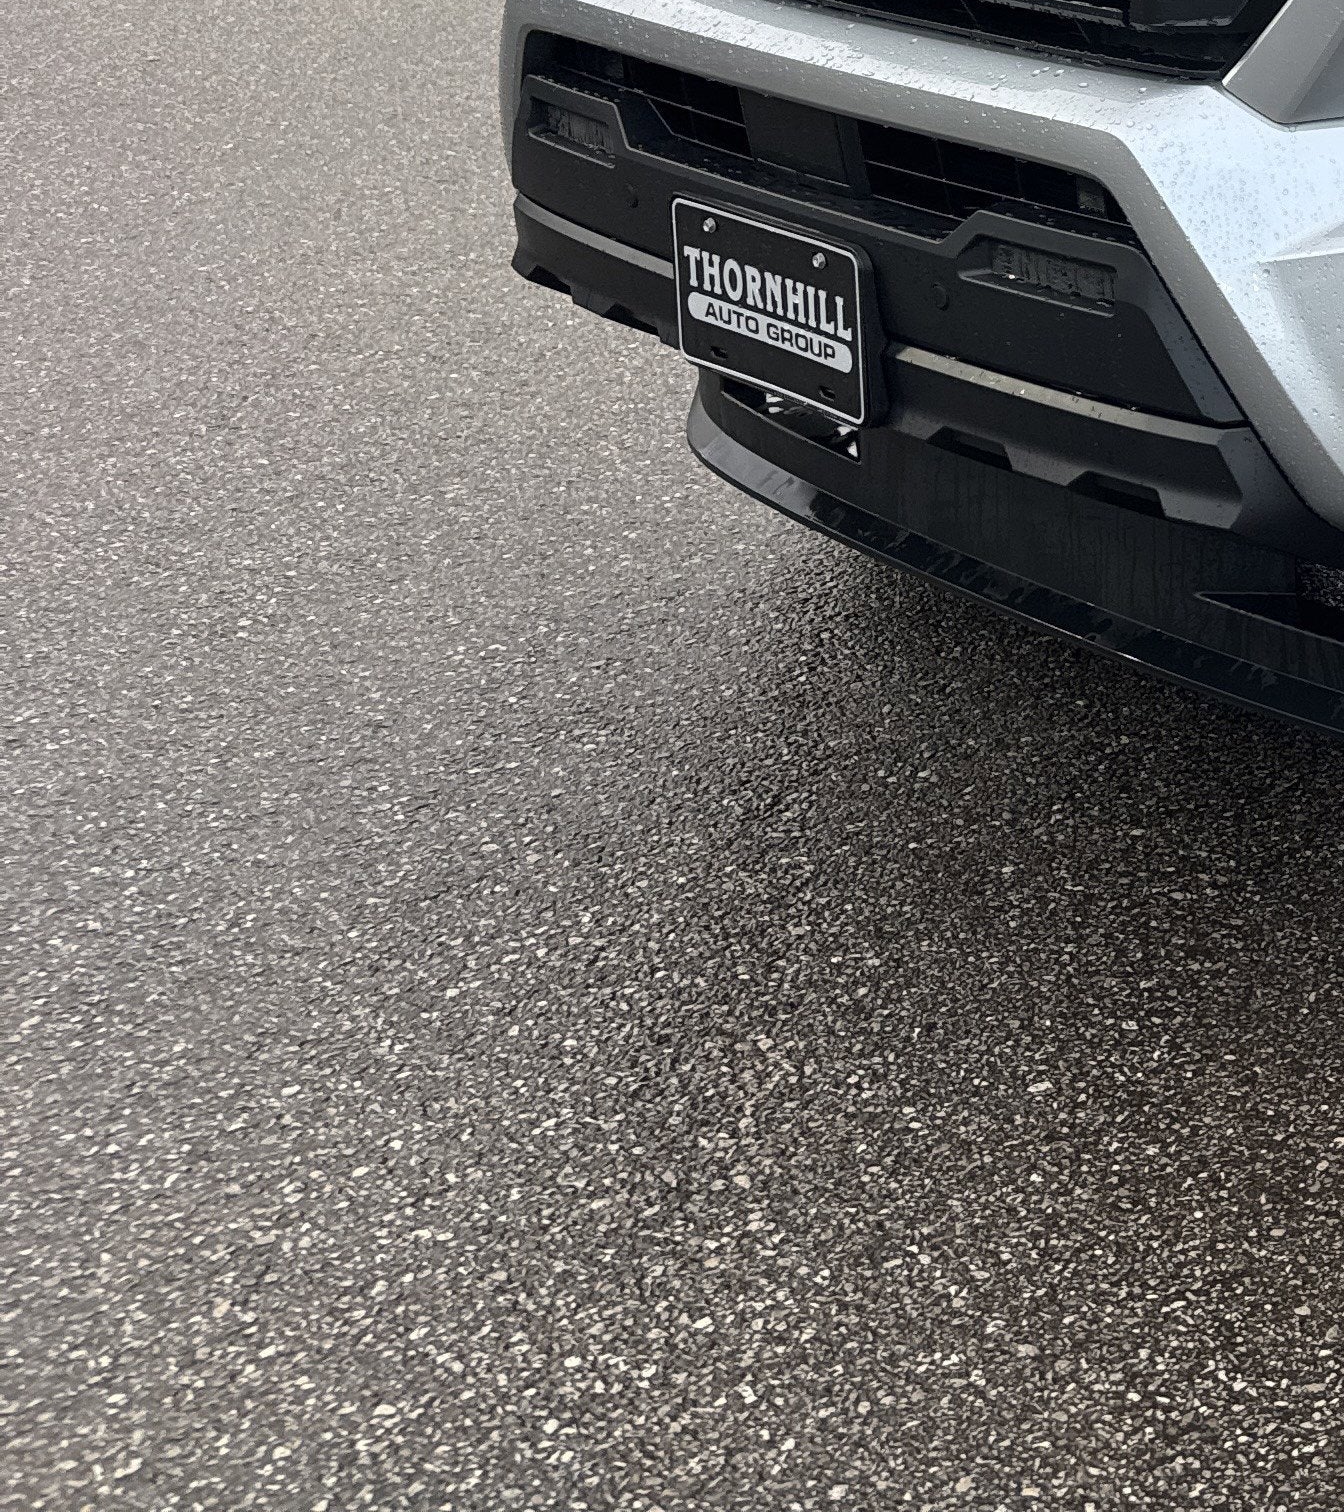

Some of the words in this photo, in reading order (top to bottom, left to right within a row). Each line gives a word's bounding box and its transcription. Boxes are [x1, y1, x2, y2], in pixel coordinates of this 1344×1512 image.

[684, 245, 852, 341] THORNHILL
[705, 302, 760, 334] AUTO
[766, 322, 836, 360] GROUP
